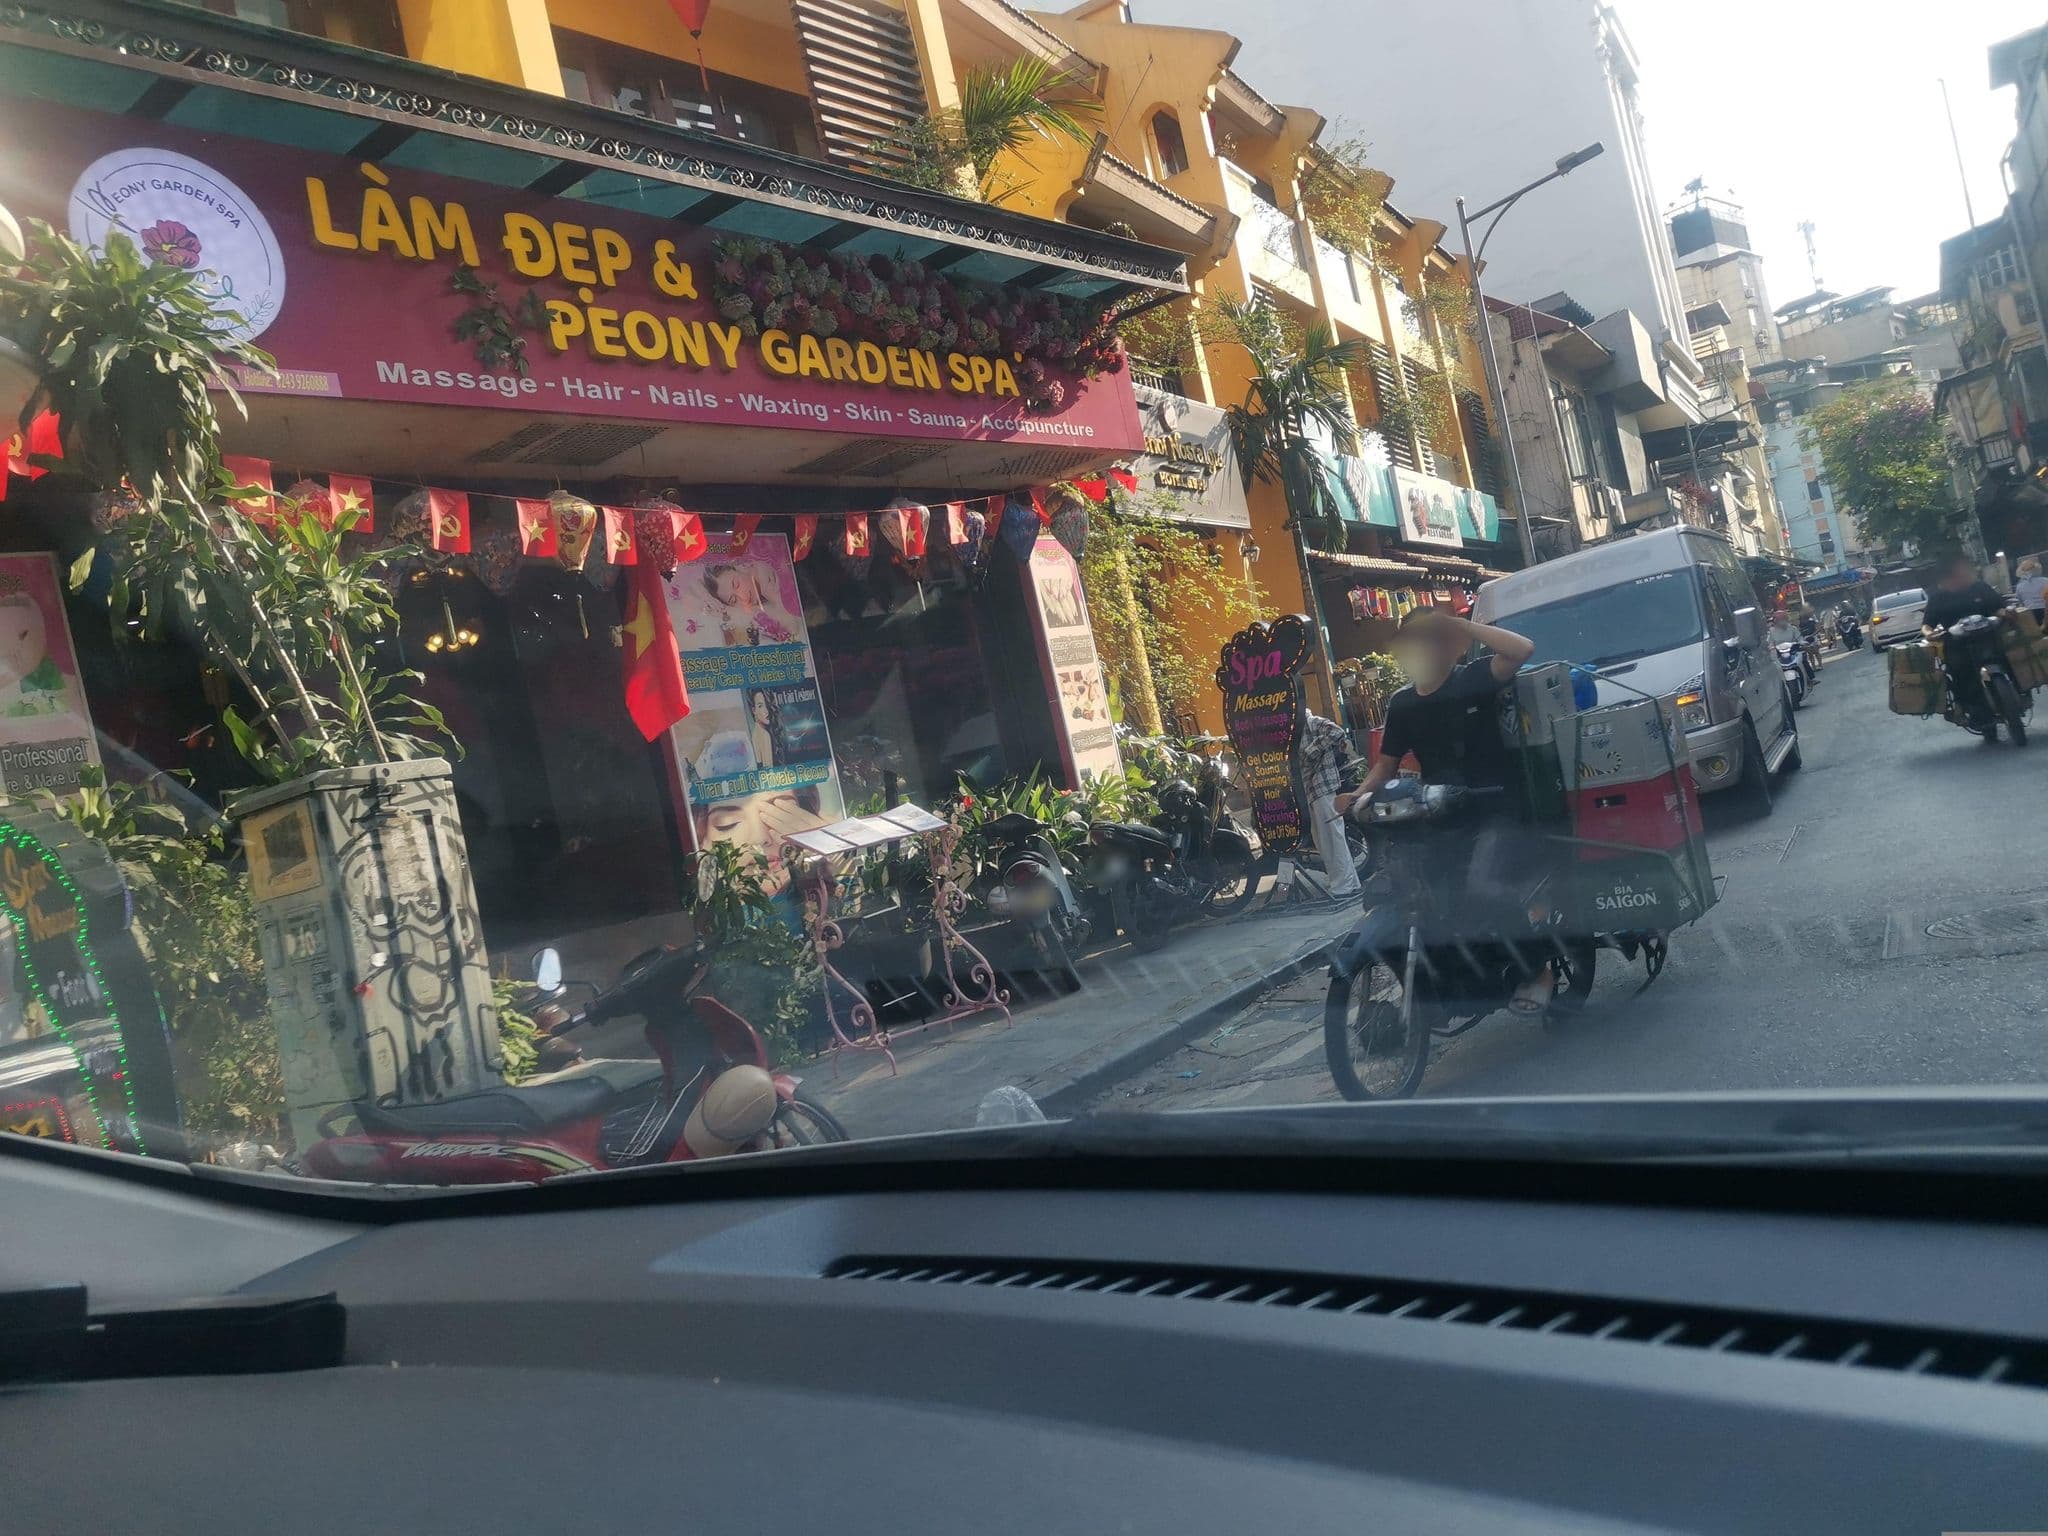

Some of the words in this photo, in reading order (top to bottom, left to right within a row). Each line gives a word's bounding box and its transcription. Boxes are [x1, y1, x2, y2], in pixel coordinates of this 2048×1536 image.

[151, 178, 214, 207] GARDEN
[215, 203, 242, 229] SPA
[305, 162, 481, 267] LÀM
[502, 211, 633, 304] ĐẸP
[652, 238, 699, 300] &
[544, 299, 742, 369] PEONY
[759, 327, 942, 390] GARDEN
[376, 360, 538, 398] Massage
[561, 376, 625, 402] Hair
[648, 384, 719, 409] Nails
[739, 392, 829, 422] Waxing
[845, 402, 892, 424] Skin
[908, 408, 967, 429] Sauna
[981, 414, 1095, 438] Accupuncture
[681, 654, 728, 673] assage
[729, 649, 806, 669] Professional
[1230, 650, 1281, 691] Spa
[688, 674, 716, 689] eauty
[1234, 691, 1287, 712] Massage
[2, 740, 87, 770] Professional
[24, 774, 33, 790] &
[34, 771, 65, 787] Make
[759, 768, 796, 789] Private
[1595, 892, 1659, 911] SAIGON
[1614, 886, 1633, 895] BIA
